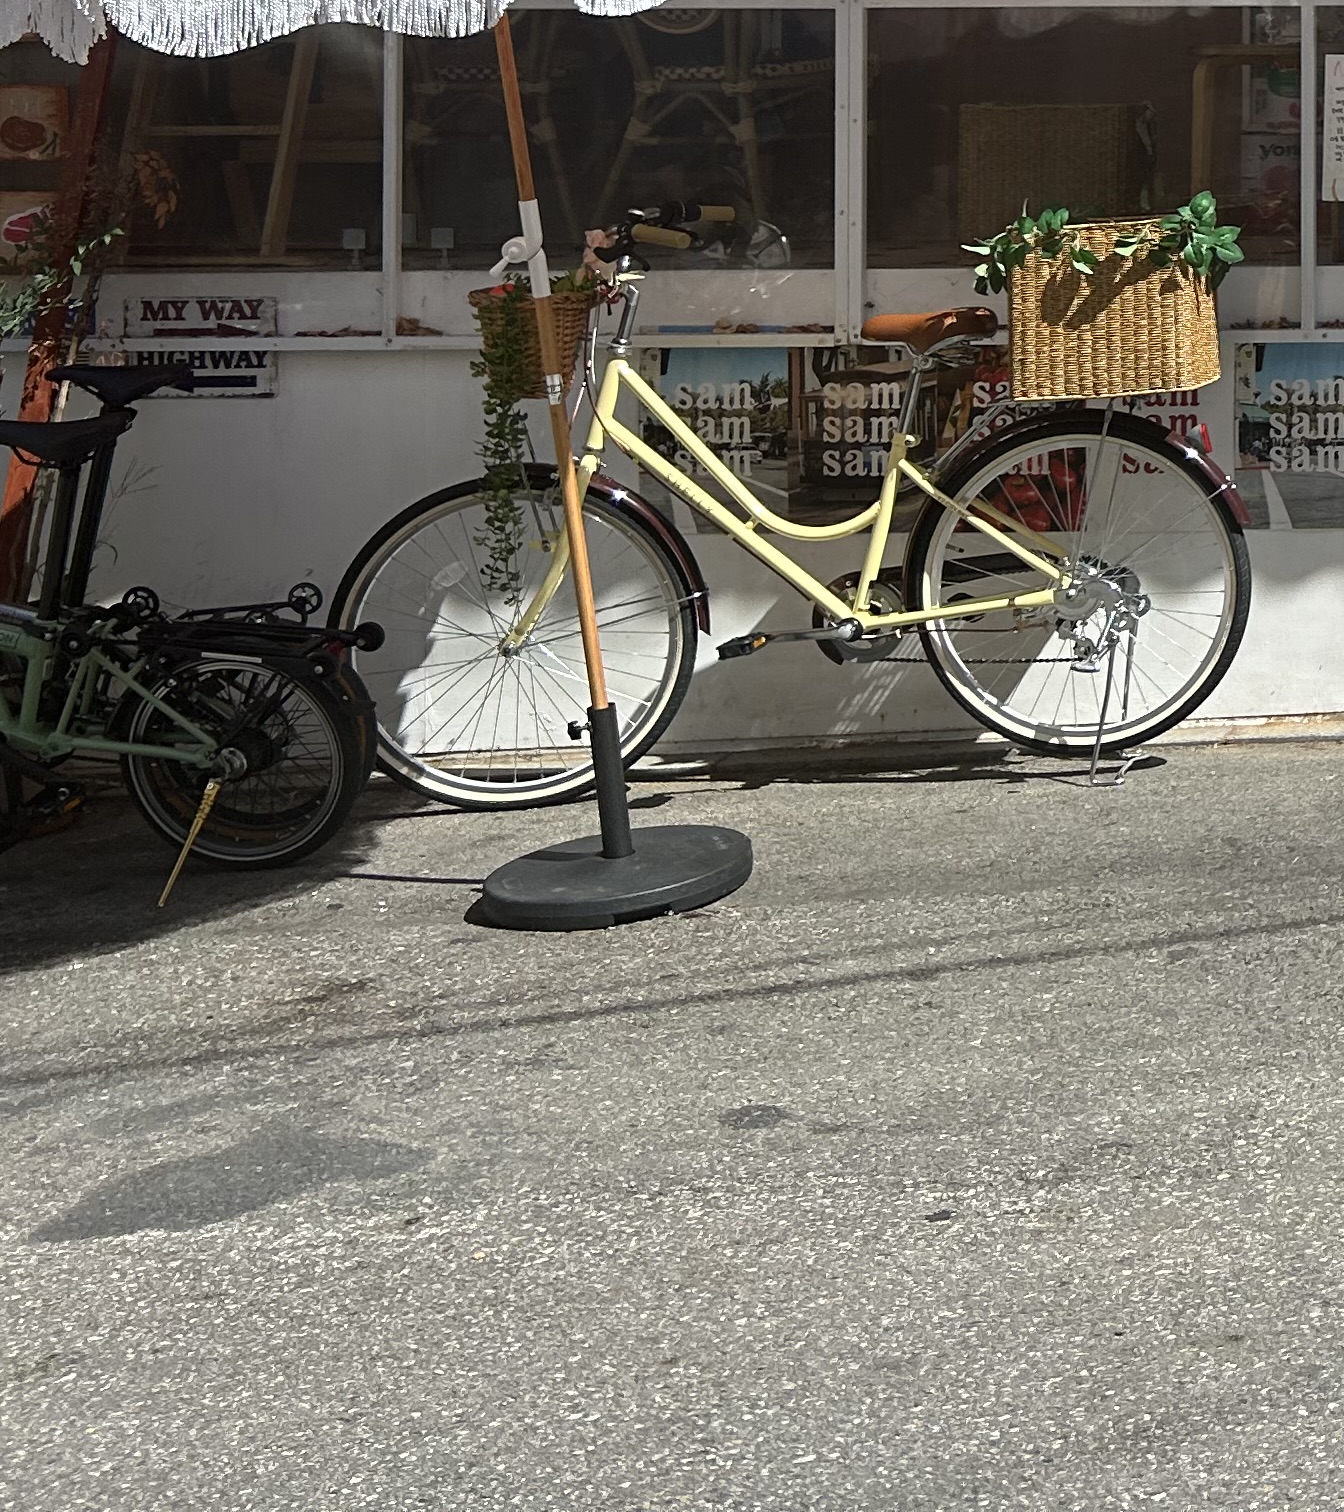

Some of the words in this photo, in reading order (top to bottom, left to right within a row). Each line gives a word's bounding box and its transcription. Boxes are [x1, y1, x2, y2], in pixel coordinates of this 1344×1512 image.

[140, 300, 189, 321] MY
[196, 299, 264, 321] WAY
[675, 382, 754, 410] sam
[823, 382, 901, 409] sam
[684, 416, 753, 445] am
